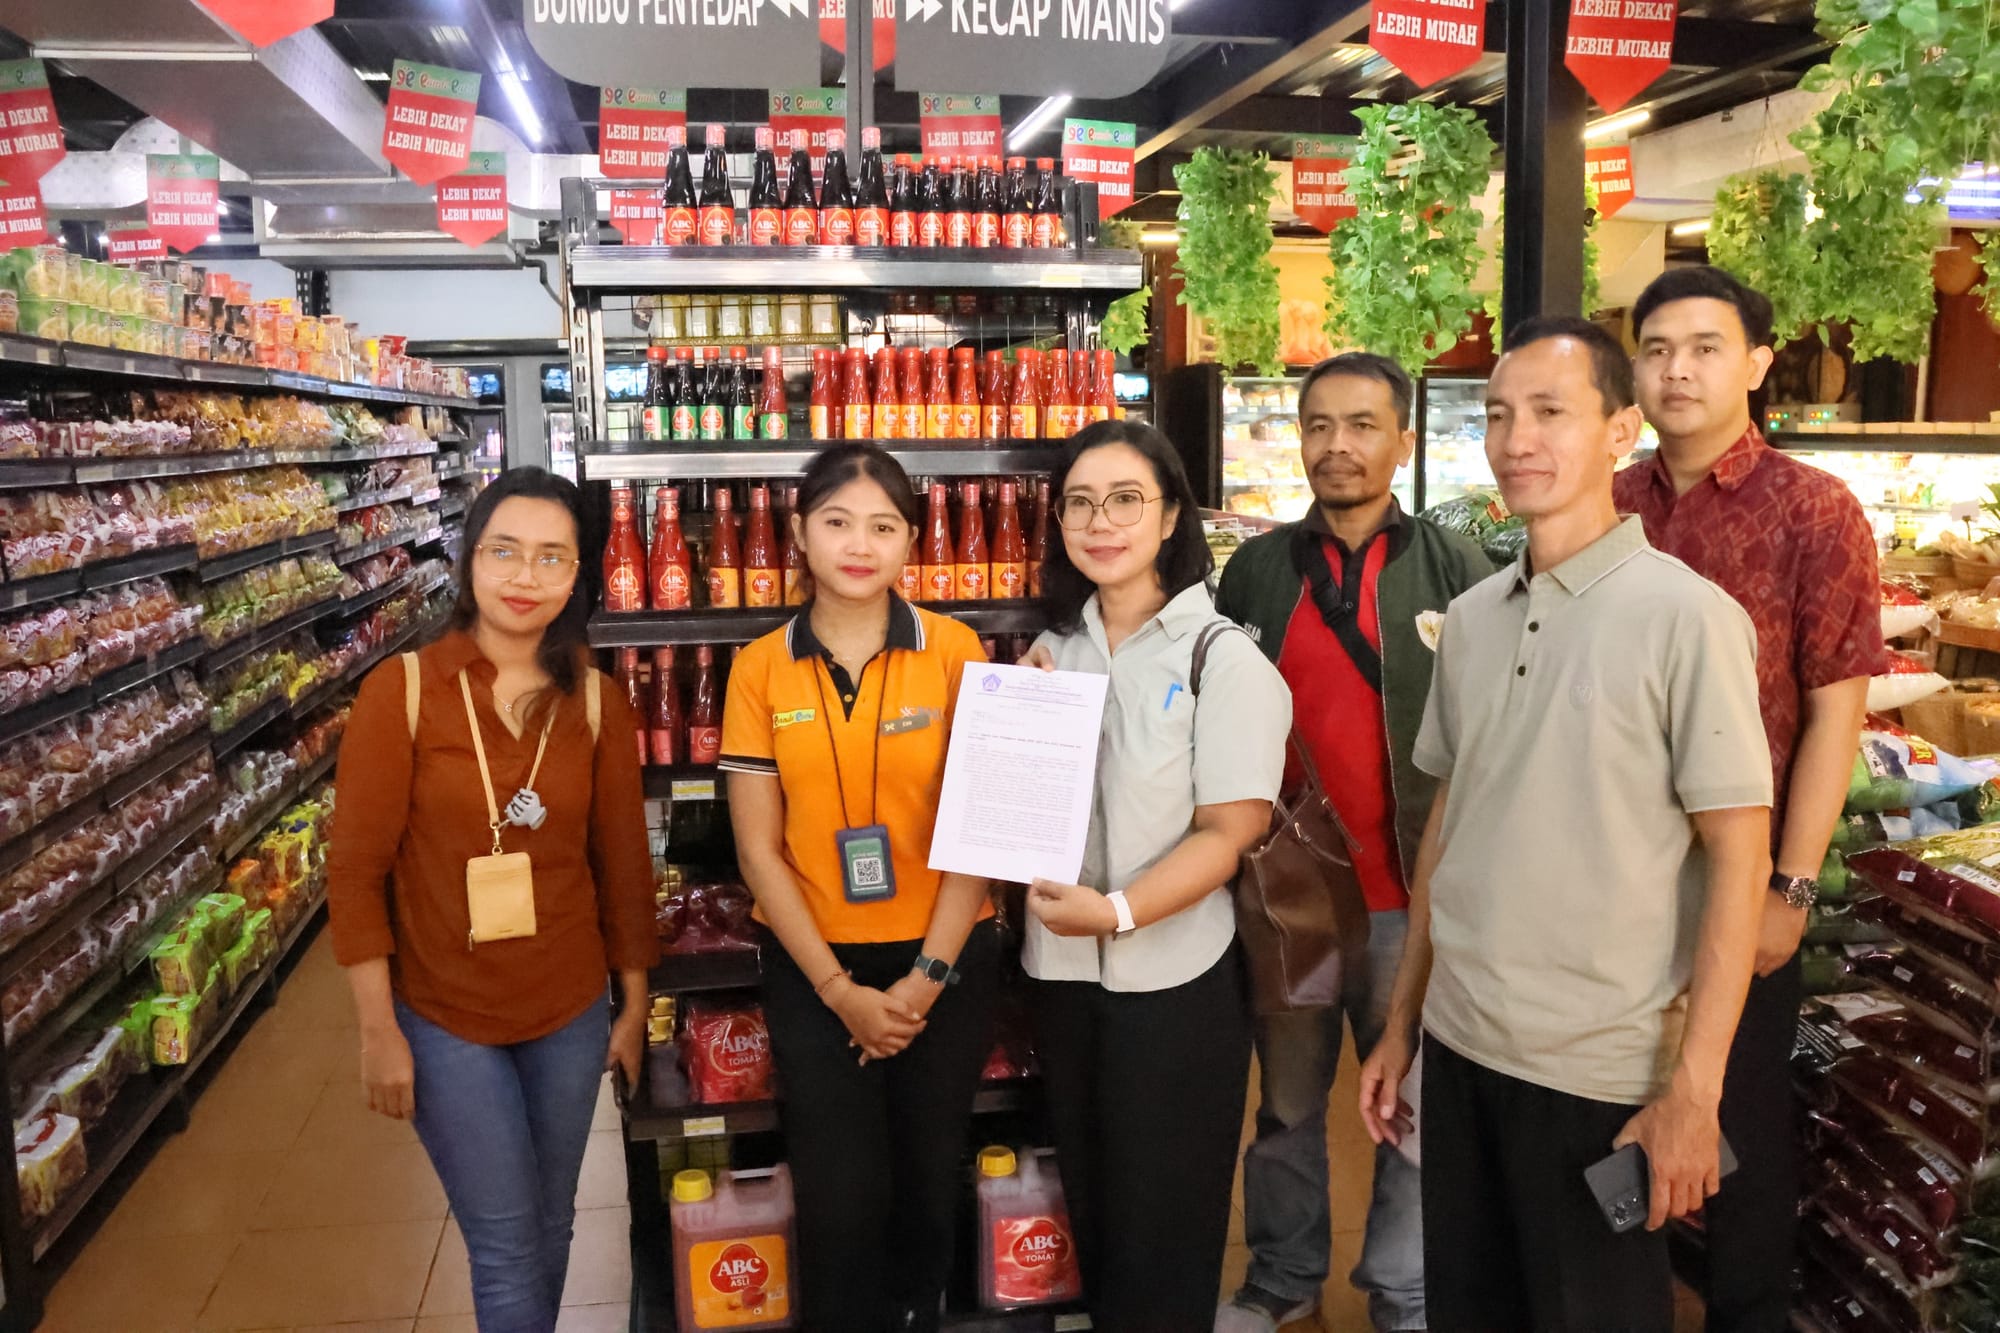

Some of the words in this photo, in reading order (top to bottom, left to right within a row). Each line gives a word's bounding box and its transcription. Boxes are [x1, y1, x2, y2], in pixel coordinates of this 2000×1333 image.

[1573, 0, 1620, 18] LEBIH
[1622, 1, 1674, 21] DEKAT
[951, 0, 1050, 37] KECAP
[1061, 0, 1165, 45] MANIS
[1377, 11, 1421, 39] LEBIH
[1425, 18, 1477, 47] MURAH
[1567, 37, 1613, 56] LEBIH
[1616, 40, 1671, 59] MURAH
[8, 106, 49, 127] DEKAT
[393, 106, 428, 127] LEBIH
[429, 111, 468, 133] DEKAT
[606, 124, 640, 140] LEBIH
[927, 132, 959, 146] LEBIH
[962, 131, 994, 145] DEKAT
[13, 133, 59, 153] MURAH
[387, 131, 422, 151] LEBIH
[425, 137, 466, 159] MURAH
[604, 149, 638, 166] LEBIH
[1068, 157, 1096, 172] LEBIH
[1098, 159, 1130, 174] DEKAT
[1298, 172, 1324, 185] LEBIH
[442, 188, 470, 201] LEBIH
[472, 188, 502, 201] DEKAT
[1296, 193, 1323, 206] LEBIH
[6, 196, 37, 212] DEKAT
[152, 212, 181, 225] LEBIH
[183, 213, 215, 226] MURAH
[442, 208, 470, 221] LEBIH
[472, 208, 504, 221] MURAH
[8, 217, 43, 233] MURAH
[671, 220, 692, 229] ABC
[707, 219, 728, 229] ABC
[755, 220, 777, 229] ABC
[788, 220, 808, 229] ABC
[827, 220, 848, 229] ABC
[111, 240, 137, 252] LEBIH
[138, 239, 162, 250] DEKAT
[613, 577, 633, 586] ABC
[666, 575, 684, 584] ABC
[1001, 572, 1019, 580] ABC
[721, 1034, 762, 1055] ABC
[1020, 1235, 1061, 1252] ABC
[1025, 1253, 1056, 1264] TOMAT
[717, 1257, 761, 1278] ABC
[730, 1276, 750, 1288] ASLI
